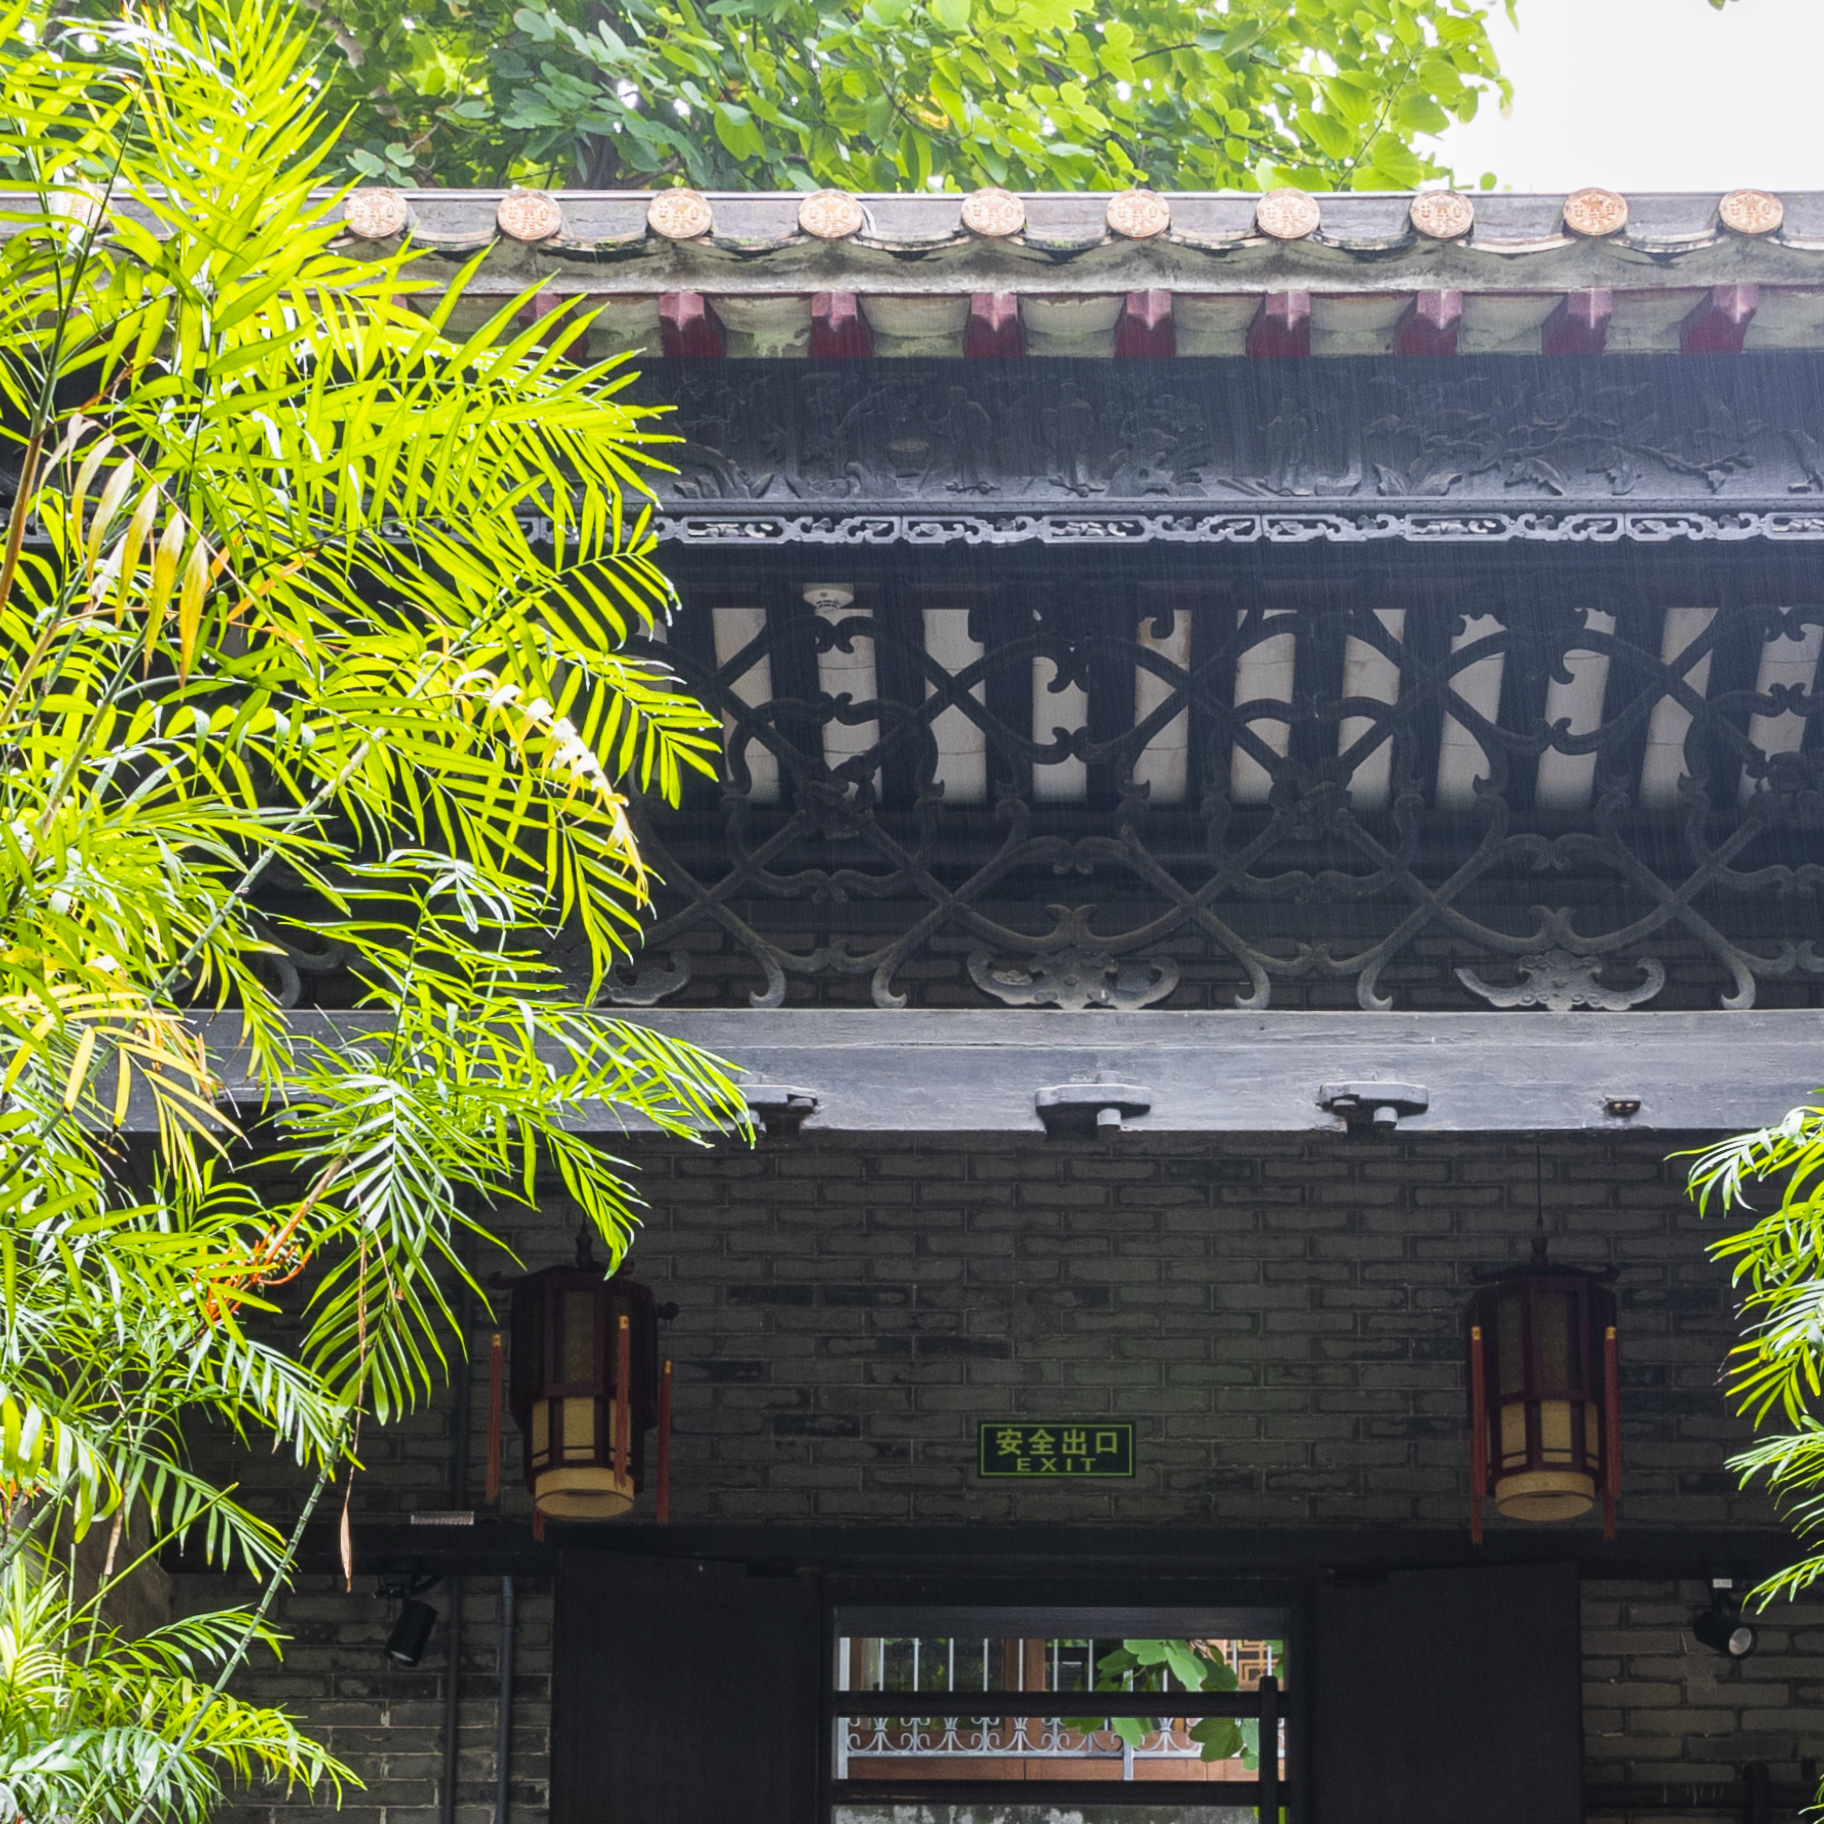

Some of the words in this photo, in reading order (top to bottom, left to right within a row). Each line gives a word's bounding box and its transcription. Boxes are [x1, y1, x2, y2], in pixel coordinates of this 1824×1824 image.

[996, 1428, 1118, 1455] 安全出口
[1016, 1458, 1096, 1472] EXIT
